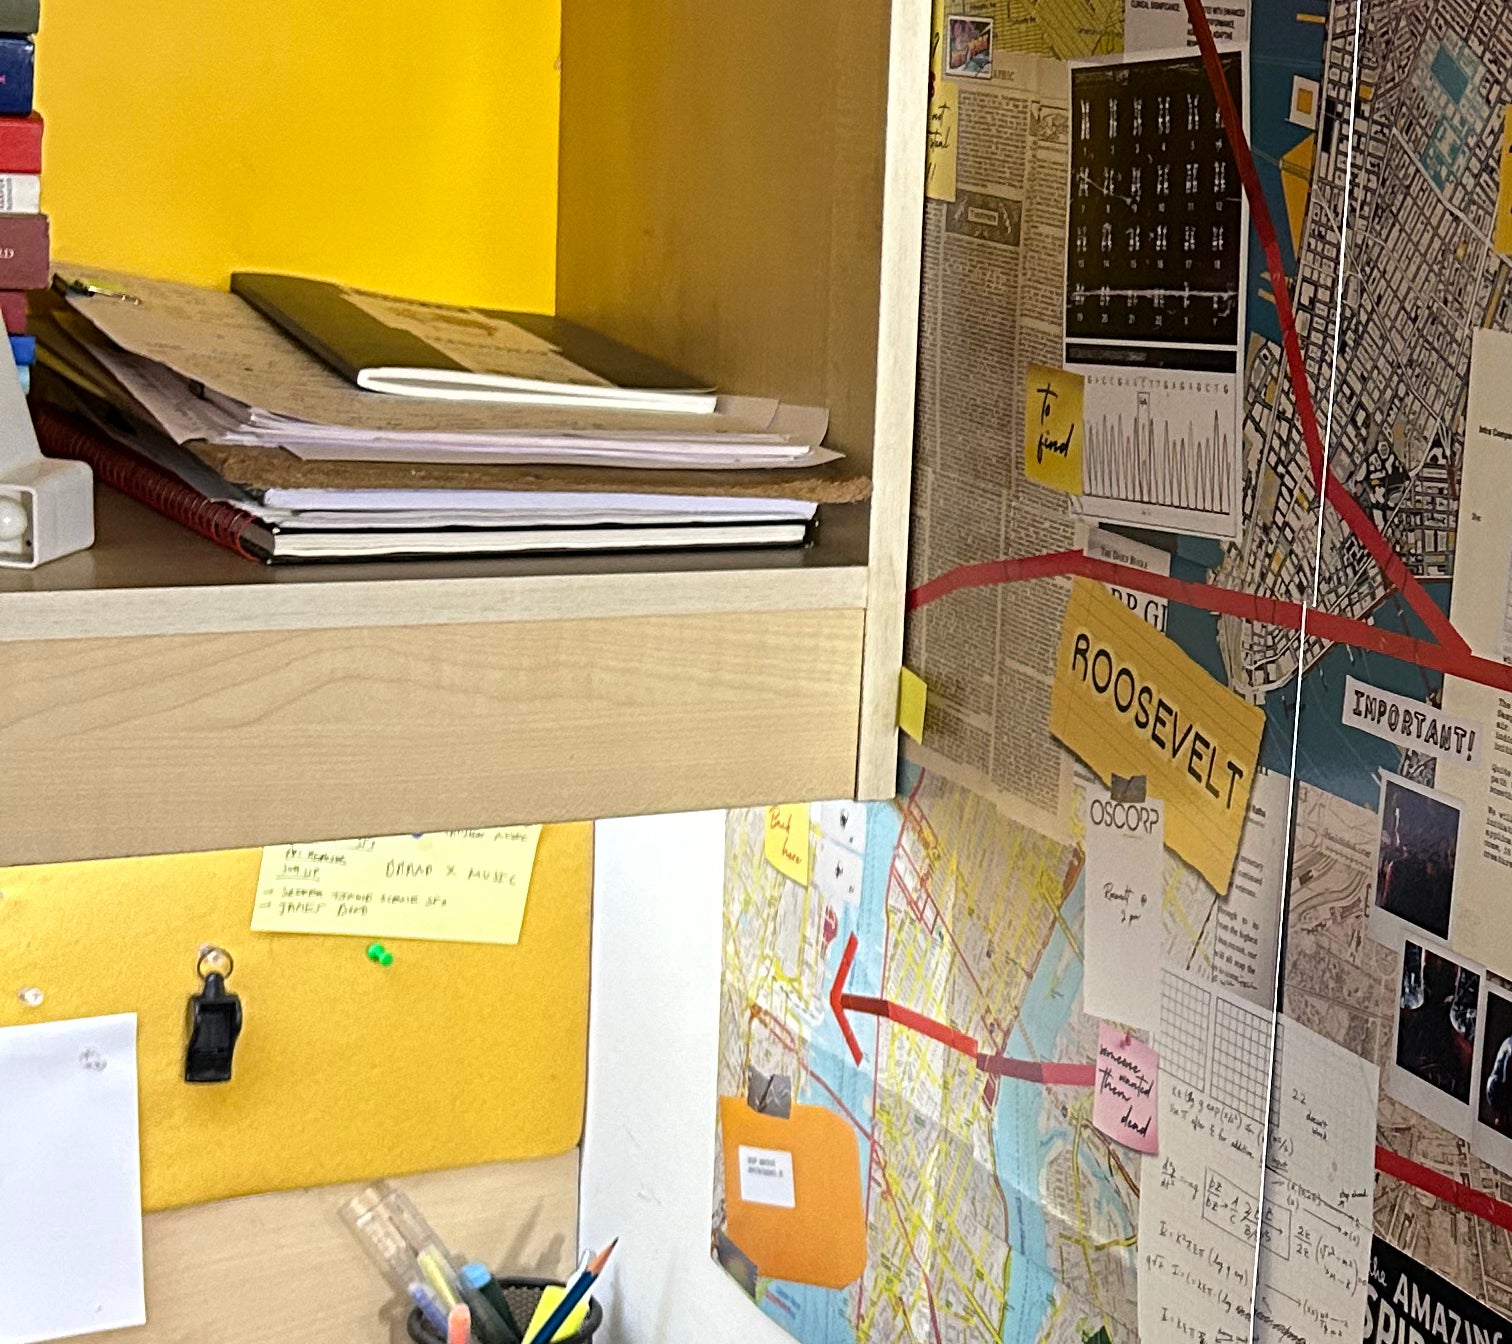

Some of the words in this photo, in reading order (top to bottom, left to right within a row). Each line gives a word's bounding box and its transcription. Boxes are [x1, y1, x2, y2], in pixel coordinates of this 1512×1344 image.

[1038, 424, 1074, 464] find
[1072, 633, 1243, 810] ROOSEVELT
[1351, 690, 1475, 761] IMPORTANT!
[1091, 798, 1159, 835] OSCORP
[1099, 1067, 1131, 1101] them
[1121, 1105, 1151, 1138] dead
